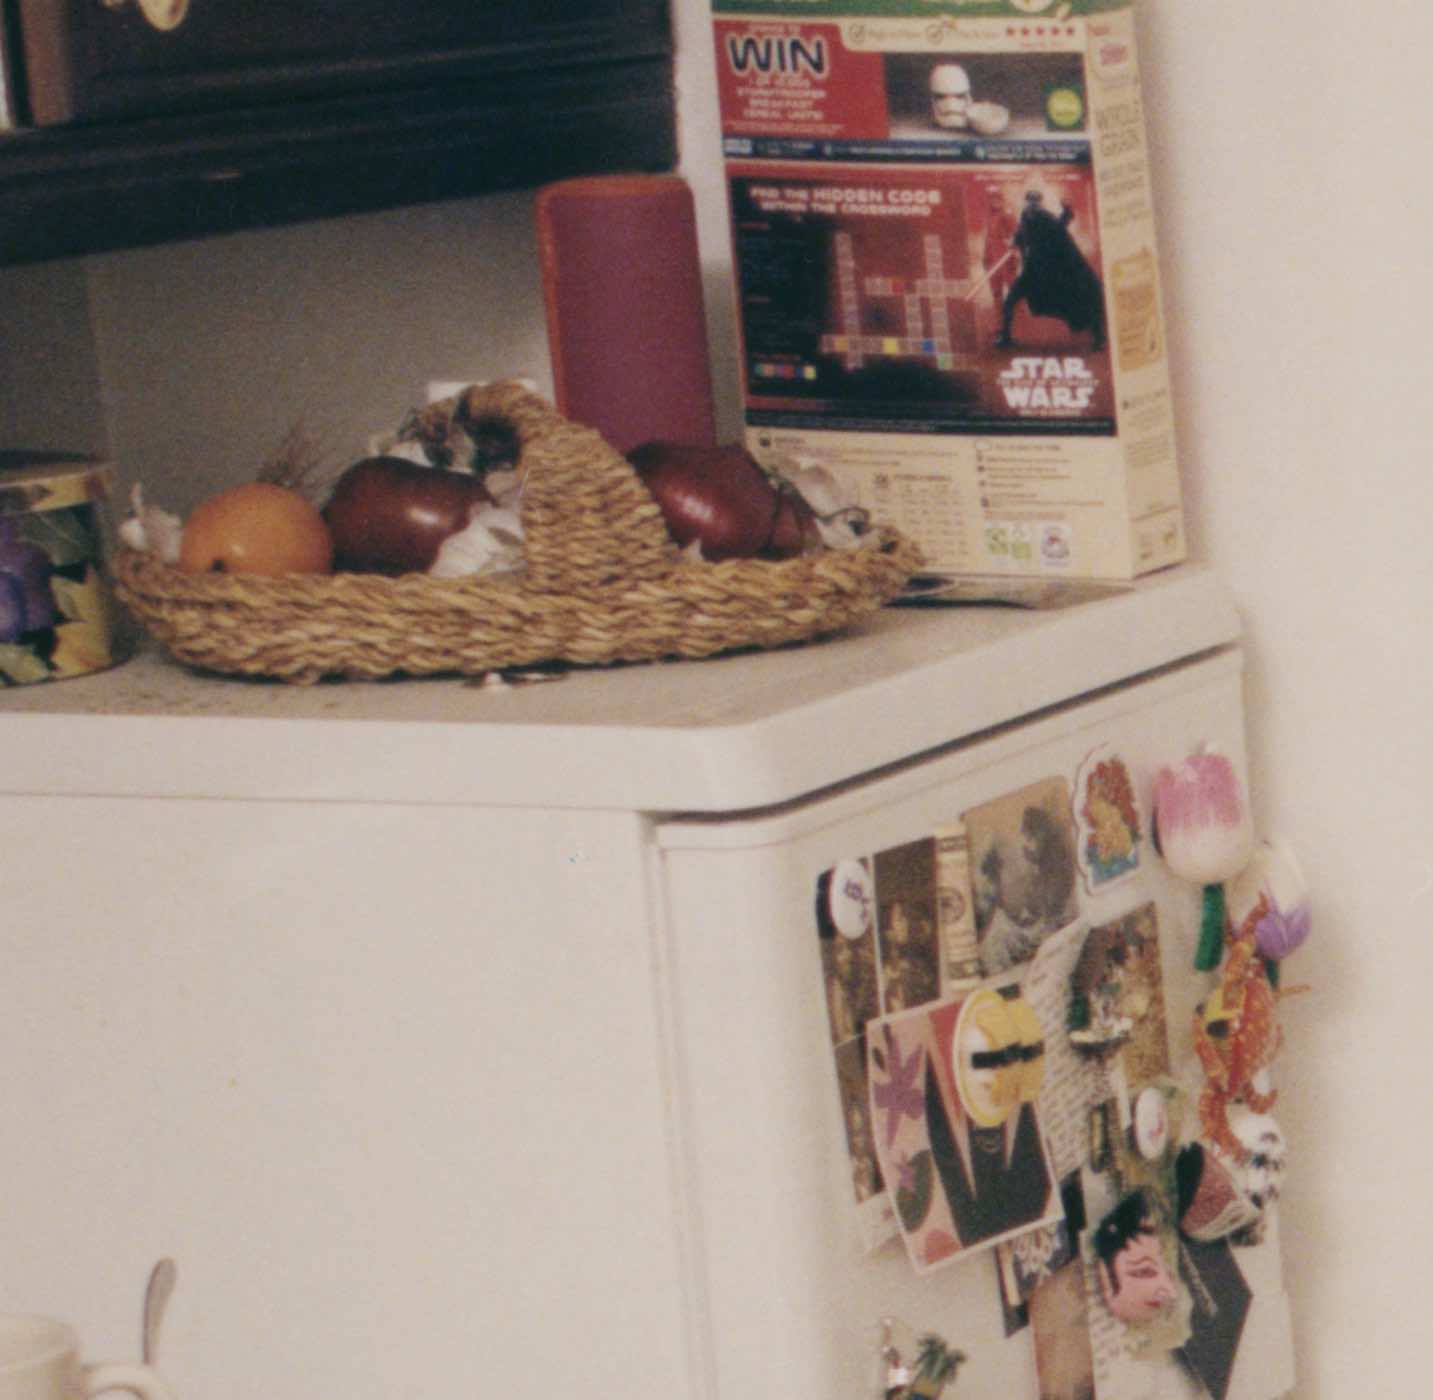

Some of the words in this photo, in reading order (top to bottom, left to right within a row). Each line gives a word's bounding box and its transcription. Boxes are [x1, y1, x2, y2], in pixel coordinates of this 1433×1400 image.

[728, 34, 828, 76] WIN
[813, 188, 884, 203] HIDDEN
[888, 189, 941, 205] CODE
[999, 356, 1094, 380] STAR
[1002, 385, 1095, 409] WARS
